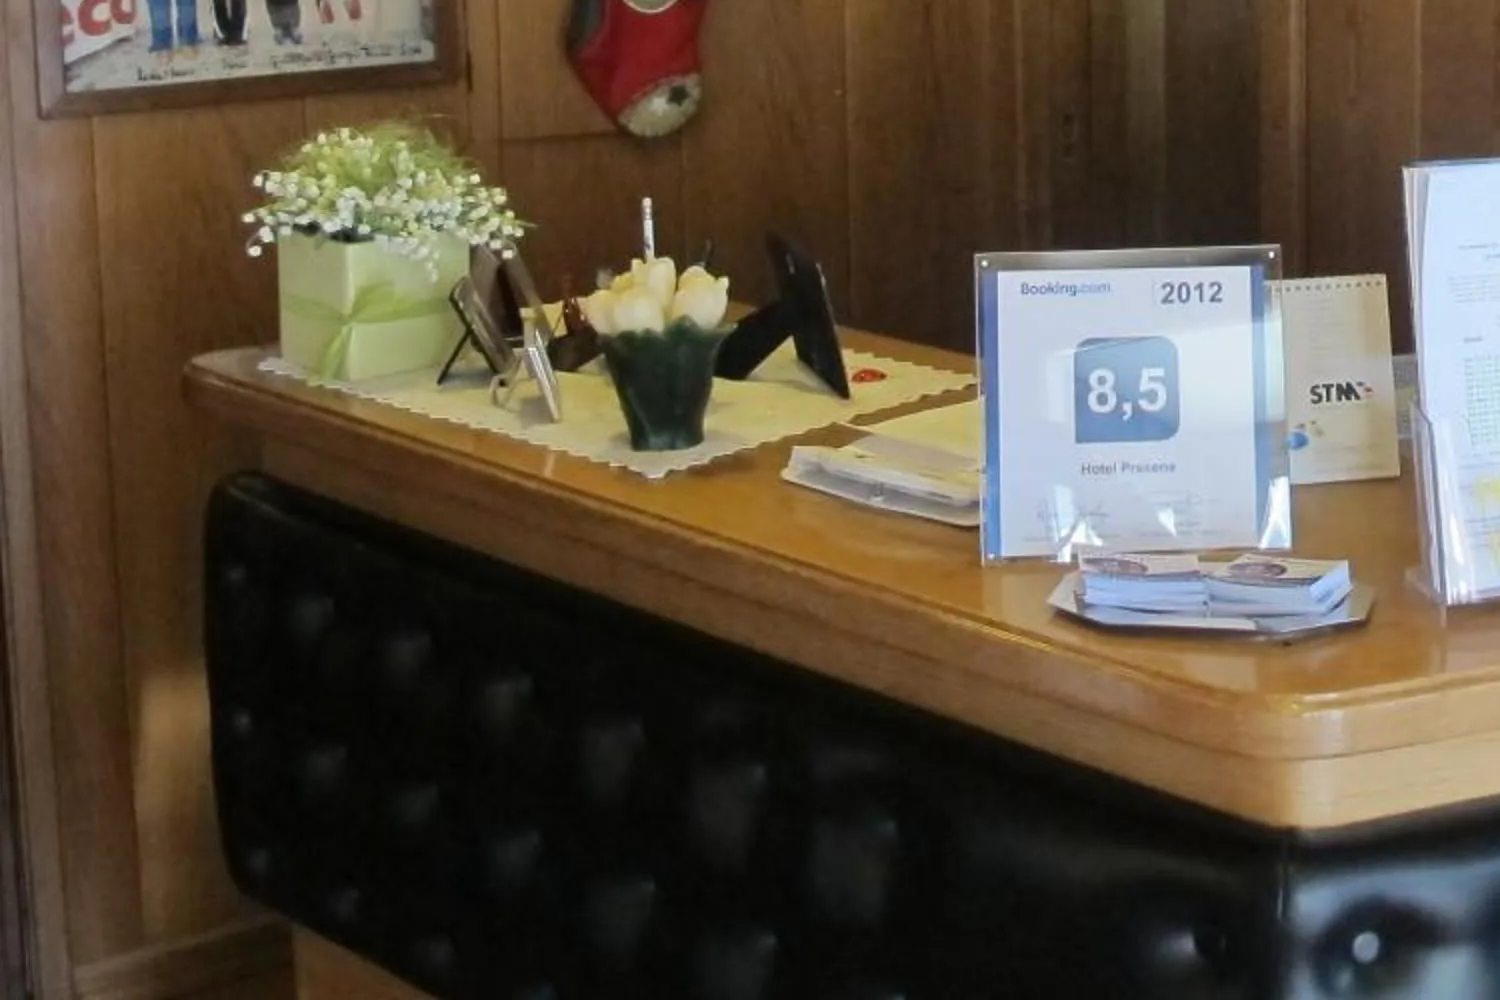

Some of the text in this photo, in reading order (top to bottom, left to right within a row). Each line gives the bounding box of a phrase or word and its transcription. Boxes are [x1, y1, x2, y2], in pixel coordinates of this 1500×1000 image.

[1020, 281, 1111, 297] Booking.com
[1160, 281, 1224, 305] 2012
[1087, 368, 1168, 421] 8,5
[1081, 462, 1118, 476] Hotel
